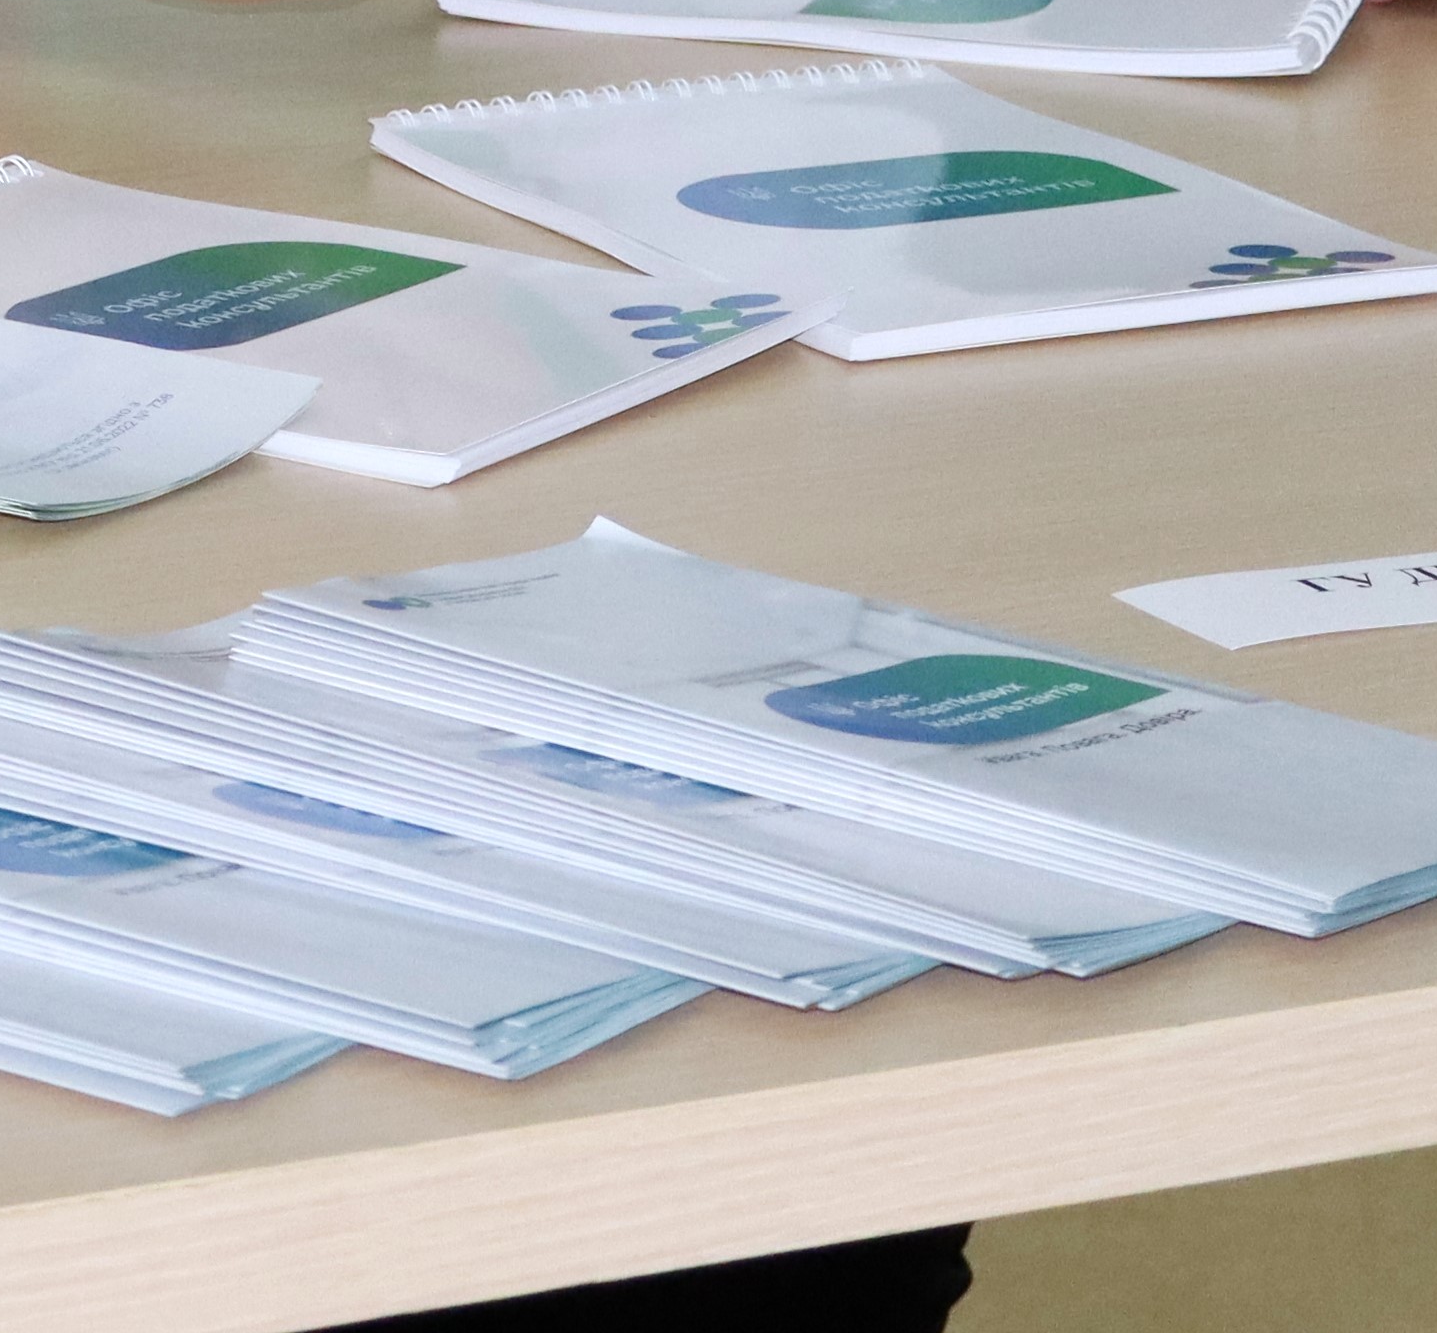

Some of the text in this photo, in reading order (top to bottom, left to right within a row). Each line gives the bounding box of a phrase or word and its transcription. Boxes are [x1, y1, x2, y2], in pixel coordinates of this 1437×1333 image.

[790, 180, 884, 195] Офіс
[104, 290, 182, 314] Офіс
[145, 269, 306, 322] податкових
[175, 265, 377, 329] консультантів
[1293, 572, 1375, 593] ГУ
